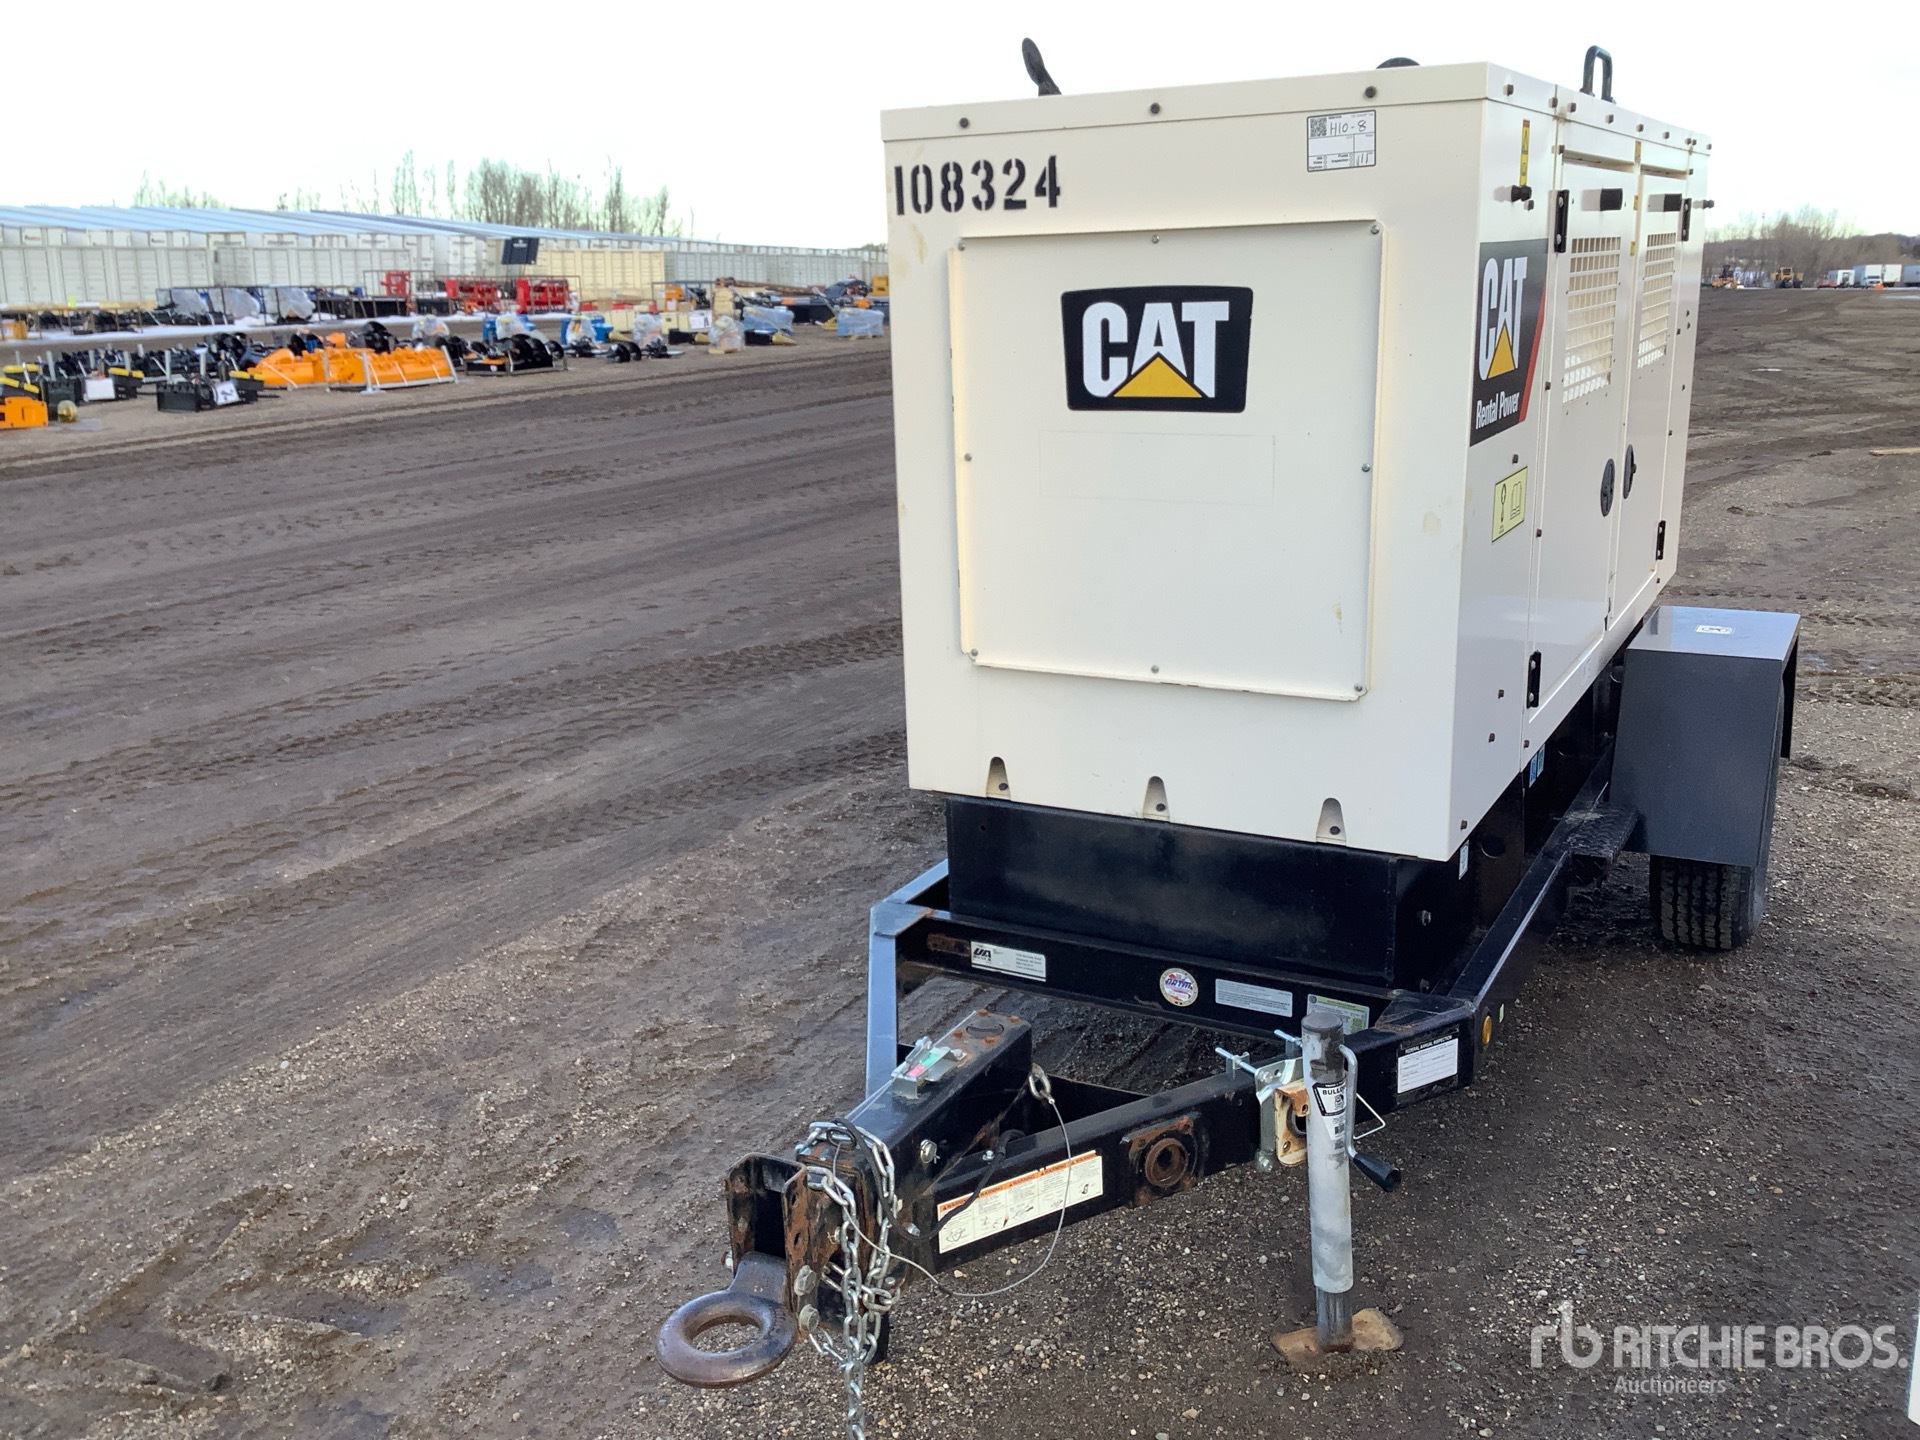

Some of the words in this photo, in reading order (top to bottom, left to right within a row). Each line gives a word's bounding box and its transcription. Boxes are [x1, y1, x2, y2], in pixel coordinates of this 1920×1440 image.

[894, 155, 1061, 215] 108324
[1082, 301, 1230, 398] CAT
[1478, 256, 1528, 380] CAT
[1475, 393, 1499, 429] Rental
[1498, 391, 1520, 419] Power
